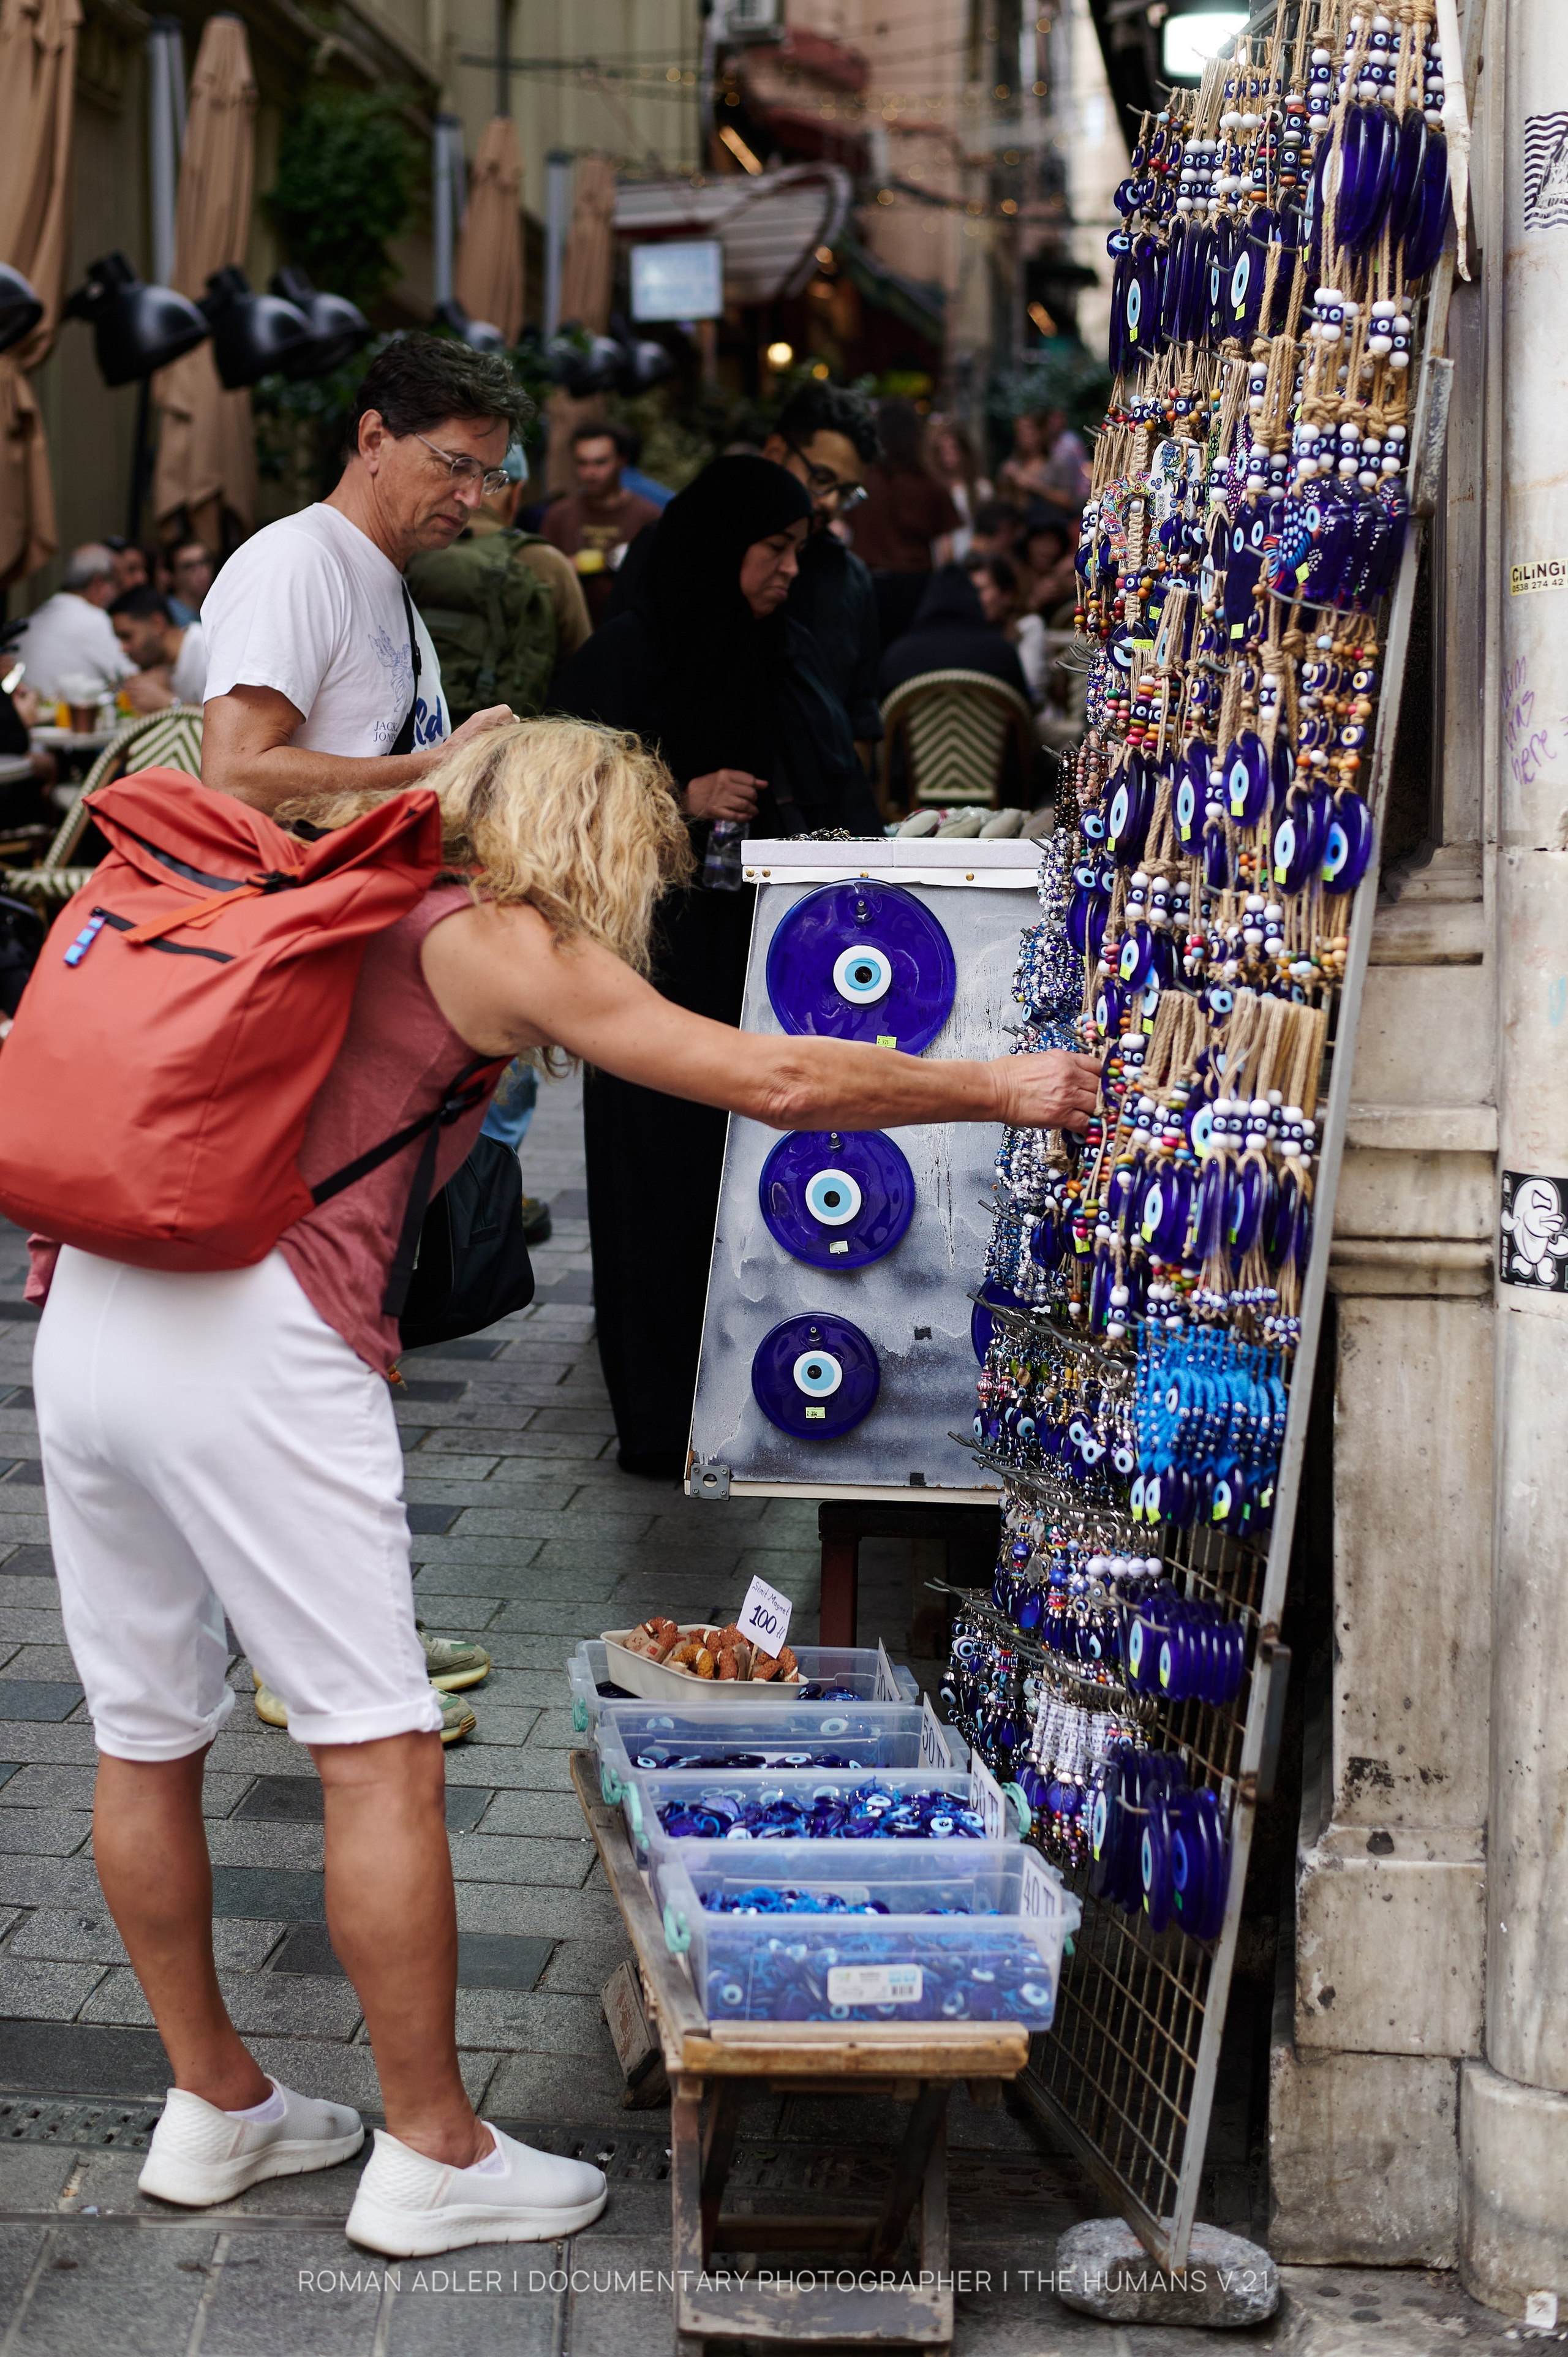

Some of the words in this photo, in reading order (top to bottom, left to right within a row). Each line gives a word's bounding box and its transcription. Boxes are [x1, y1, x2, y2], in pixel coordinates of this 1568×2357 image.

[1532, 580, 1548, 590] 274
[1552, 578, 1564, 586] 42
[752, 1581, 769, 1598] Simit
[768, 1593, 791, 1616] Magnet
[749, 1605, 777, 1634] 100
[922, 1713, 935, 1764] 50
[971, 1770, 986, 1819] 50
